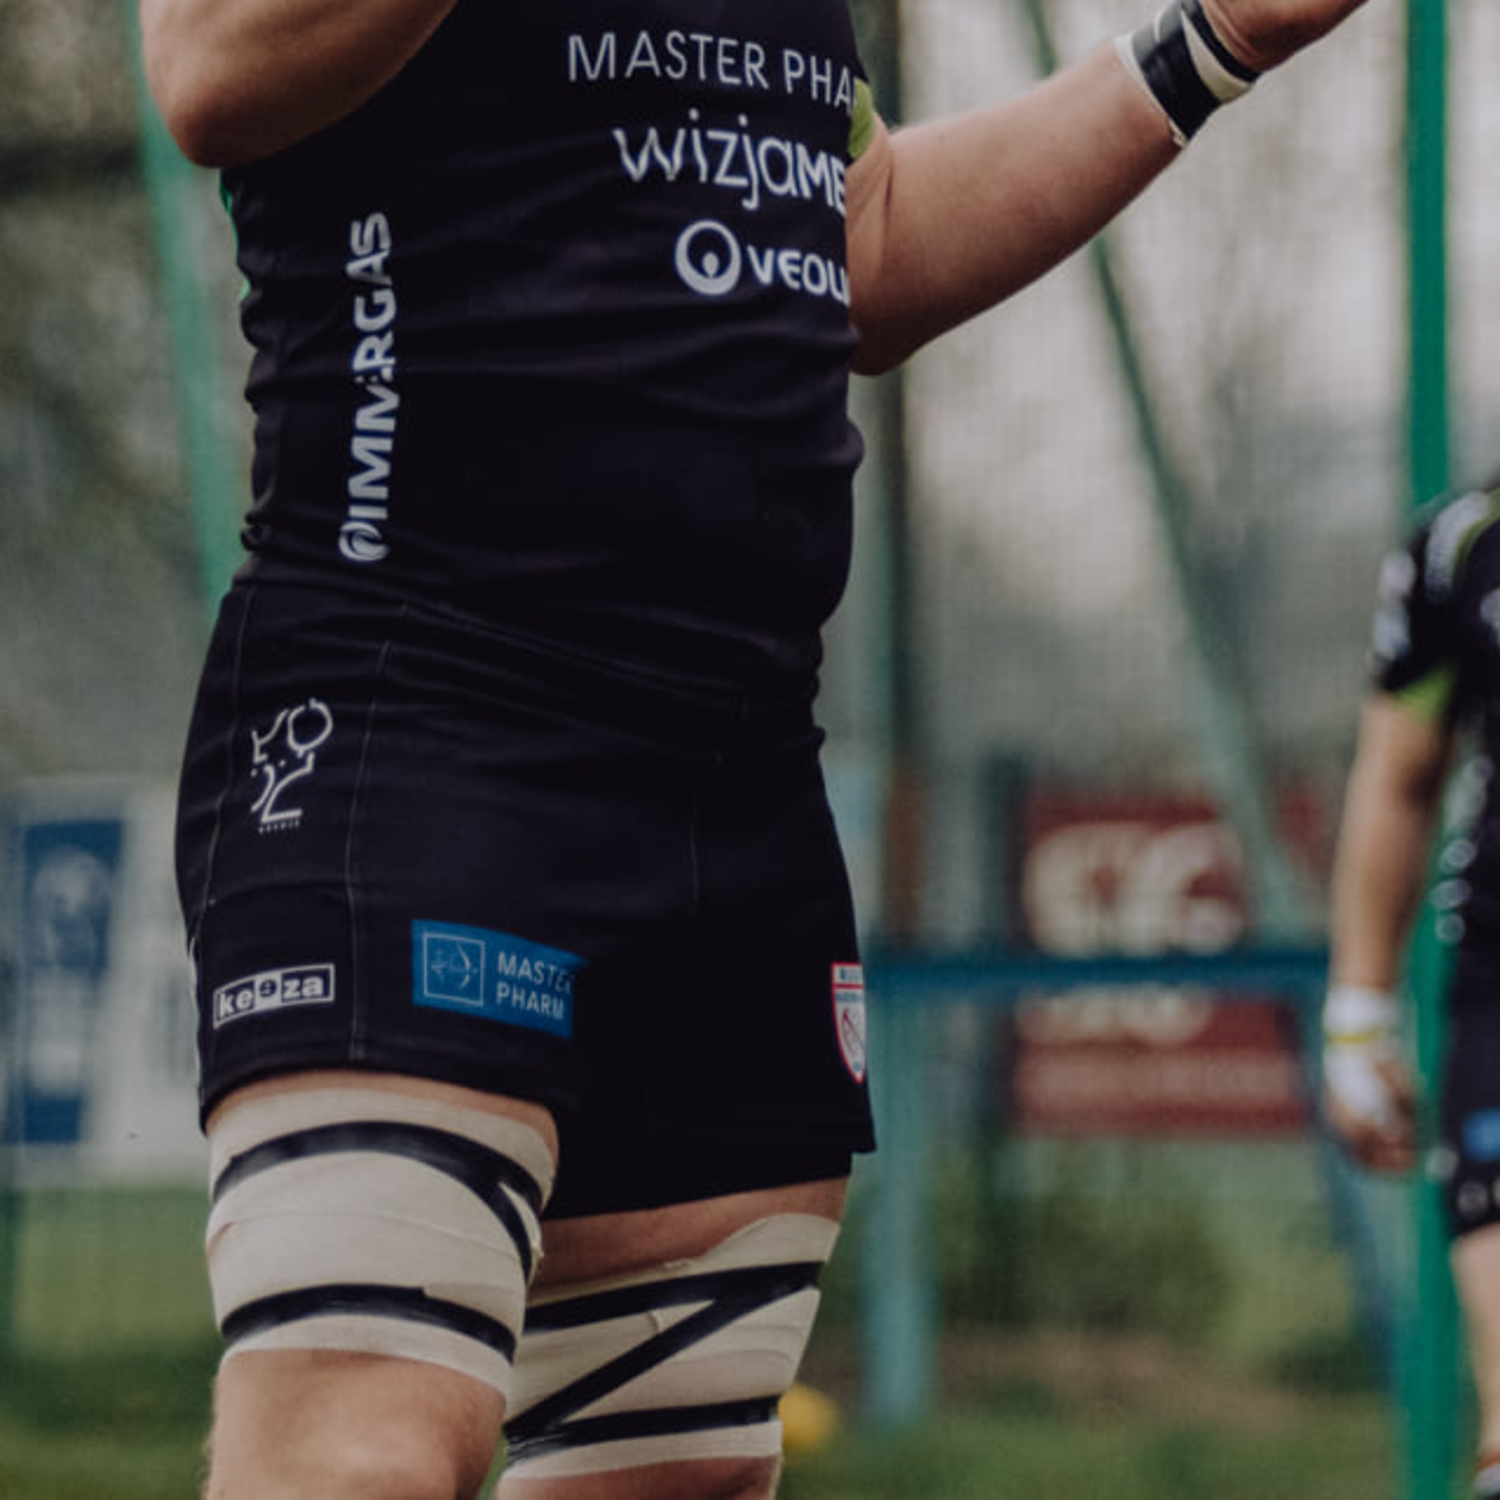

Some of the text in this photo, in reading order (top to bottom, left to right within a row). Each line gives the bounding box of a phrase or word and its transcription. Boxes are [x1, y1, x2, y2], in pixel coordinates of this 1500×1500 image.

[568, 30, 856, 117] MASTER PHA
[611, 106, 847, 218] wizjaME
